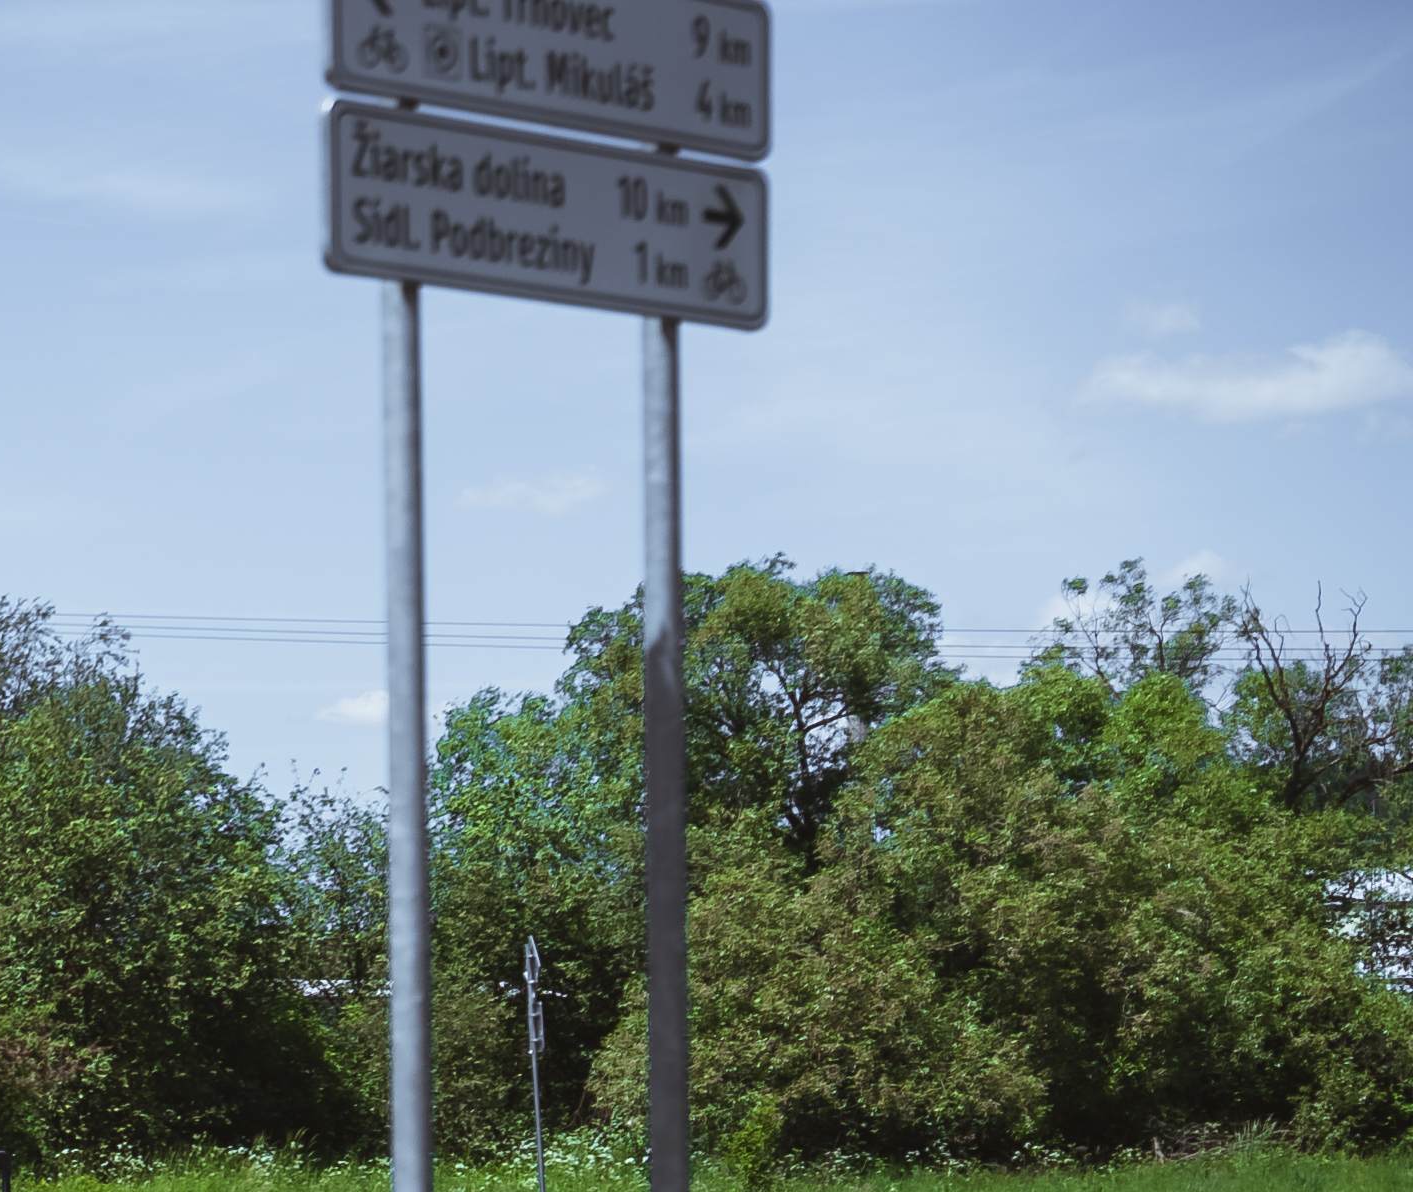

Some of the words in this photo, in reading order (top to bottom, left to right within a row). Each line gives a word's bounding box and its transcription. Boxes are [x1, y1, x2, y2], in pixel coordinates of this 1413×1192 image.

[469, 37, 536, 94] Lipt.
[545, 49, 655, 112] Mikuláš
[694, 78, 712, 121] 4
[719, 89, 752, 128] km
[691, 14, 710, 58] 9
[719, 28, 752, 67] km
[351, 118, 464, 192] Žiarska
[472, 152, 566, 208] dolina
[619, 174, 648, 221] 10
[655, 188, 689, 227] km
[430, 208, 595, 285] Podbreziny
[636, 240, 648, 284] 1
[655, 252, 689, 290] km
